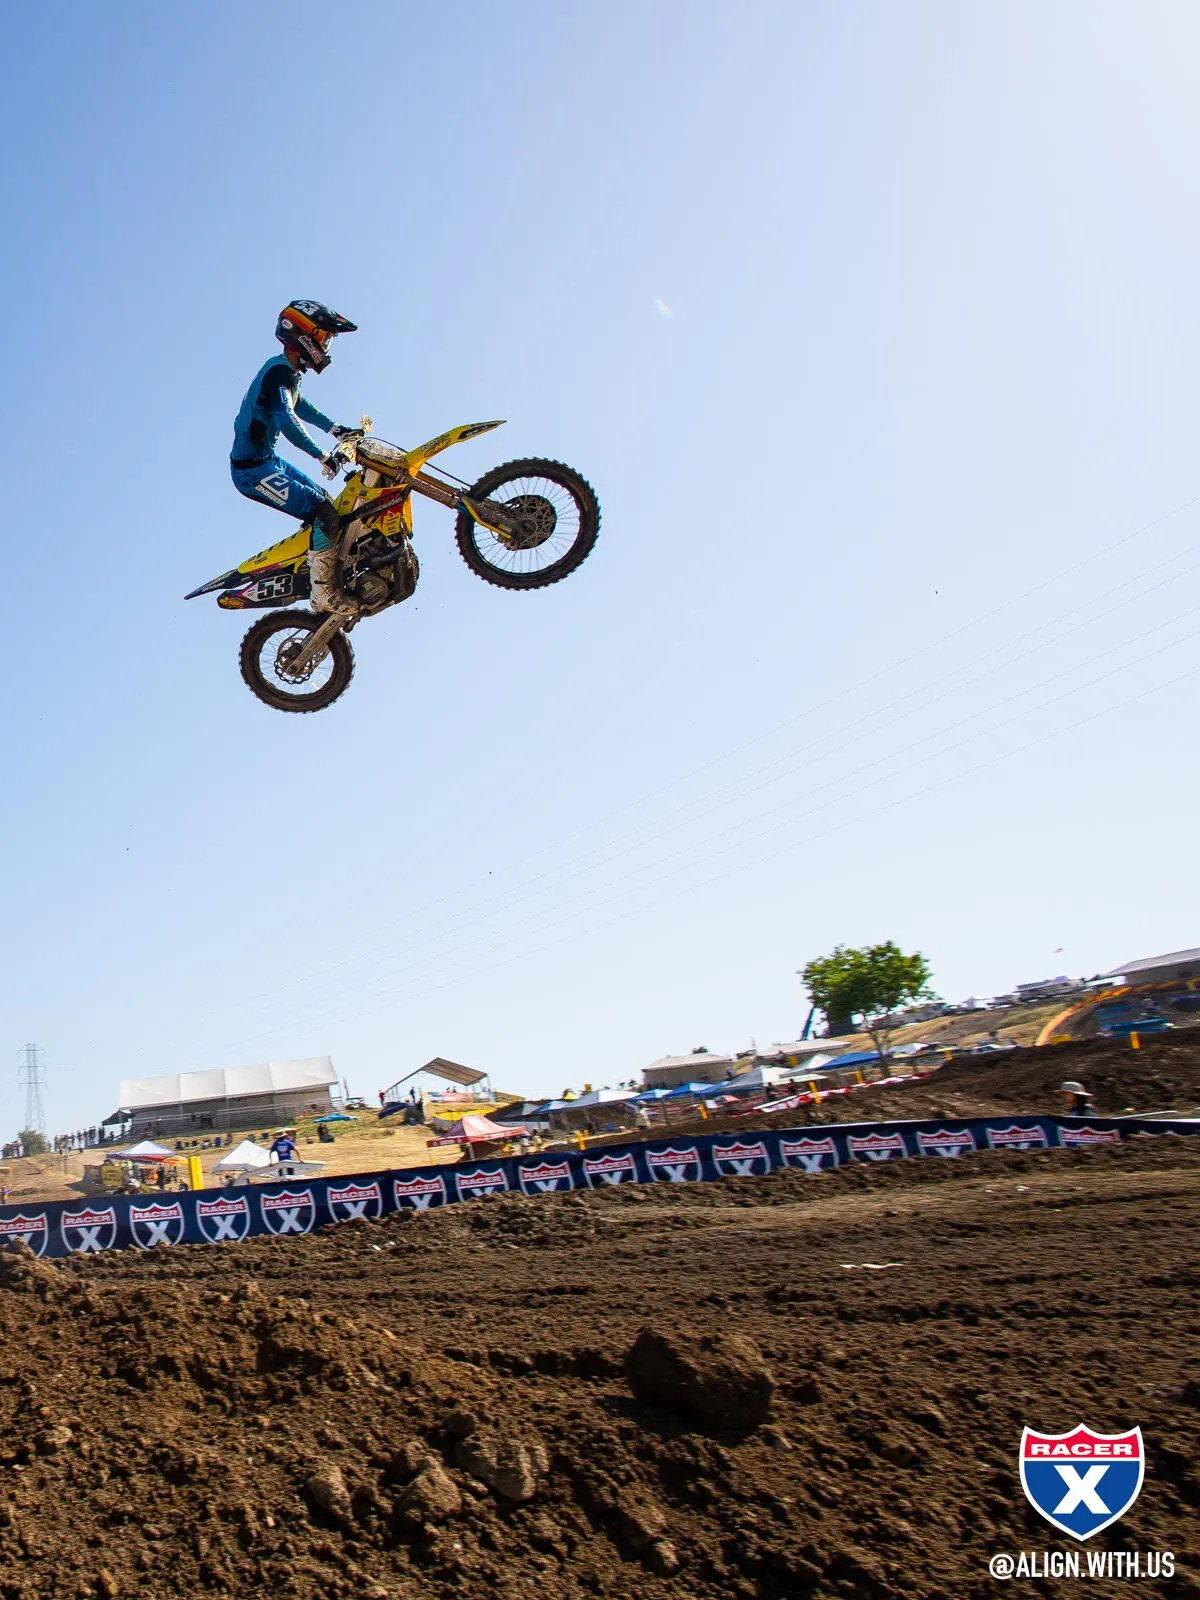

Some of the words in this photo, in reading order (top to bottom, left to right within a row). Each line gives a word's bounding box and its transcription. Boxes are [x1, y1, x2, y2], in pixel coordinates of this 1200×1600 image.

[257, 574, 293, 600] 53
[650, 1153, 694, 1164] RACER
[523, 1168, 566, 1179] RACER
[460, 1176, 501, 1187] RACER
[398, 1182, 440, 1193] RACER
[331, 1189, 375, 1200] RACER
[264, 1196, 309, 1207] RACER
[200, 1203, 244, 1214] RACER
[65, 1214, 111, 1225] RACER
[133, 1209, 178, 1220] RACER
[275, 1207, 305, 1234] X
[211, 1215, 240, 1240] X
[144, 1220, 172, 1247] X
[76, 1226, 102, 1253] X
